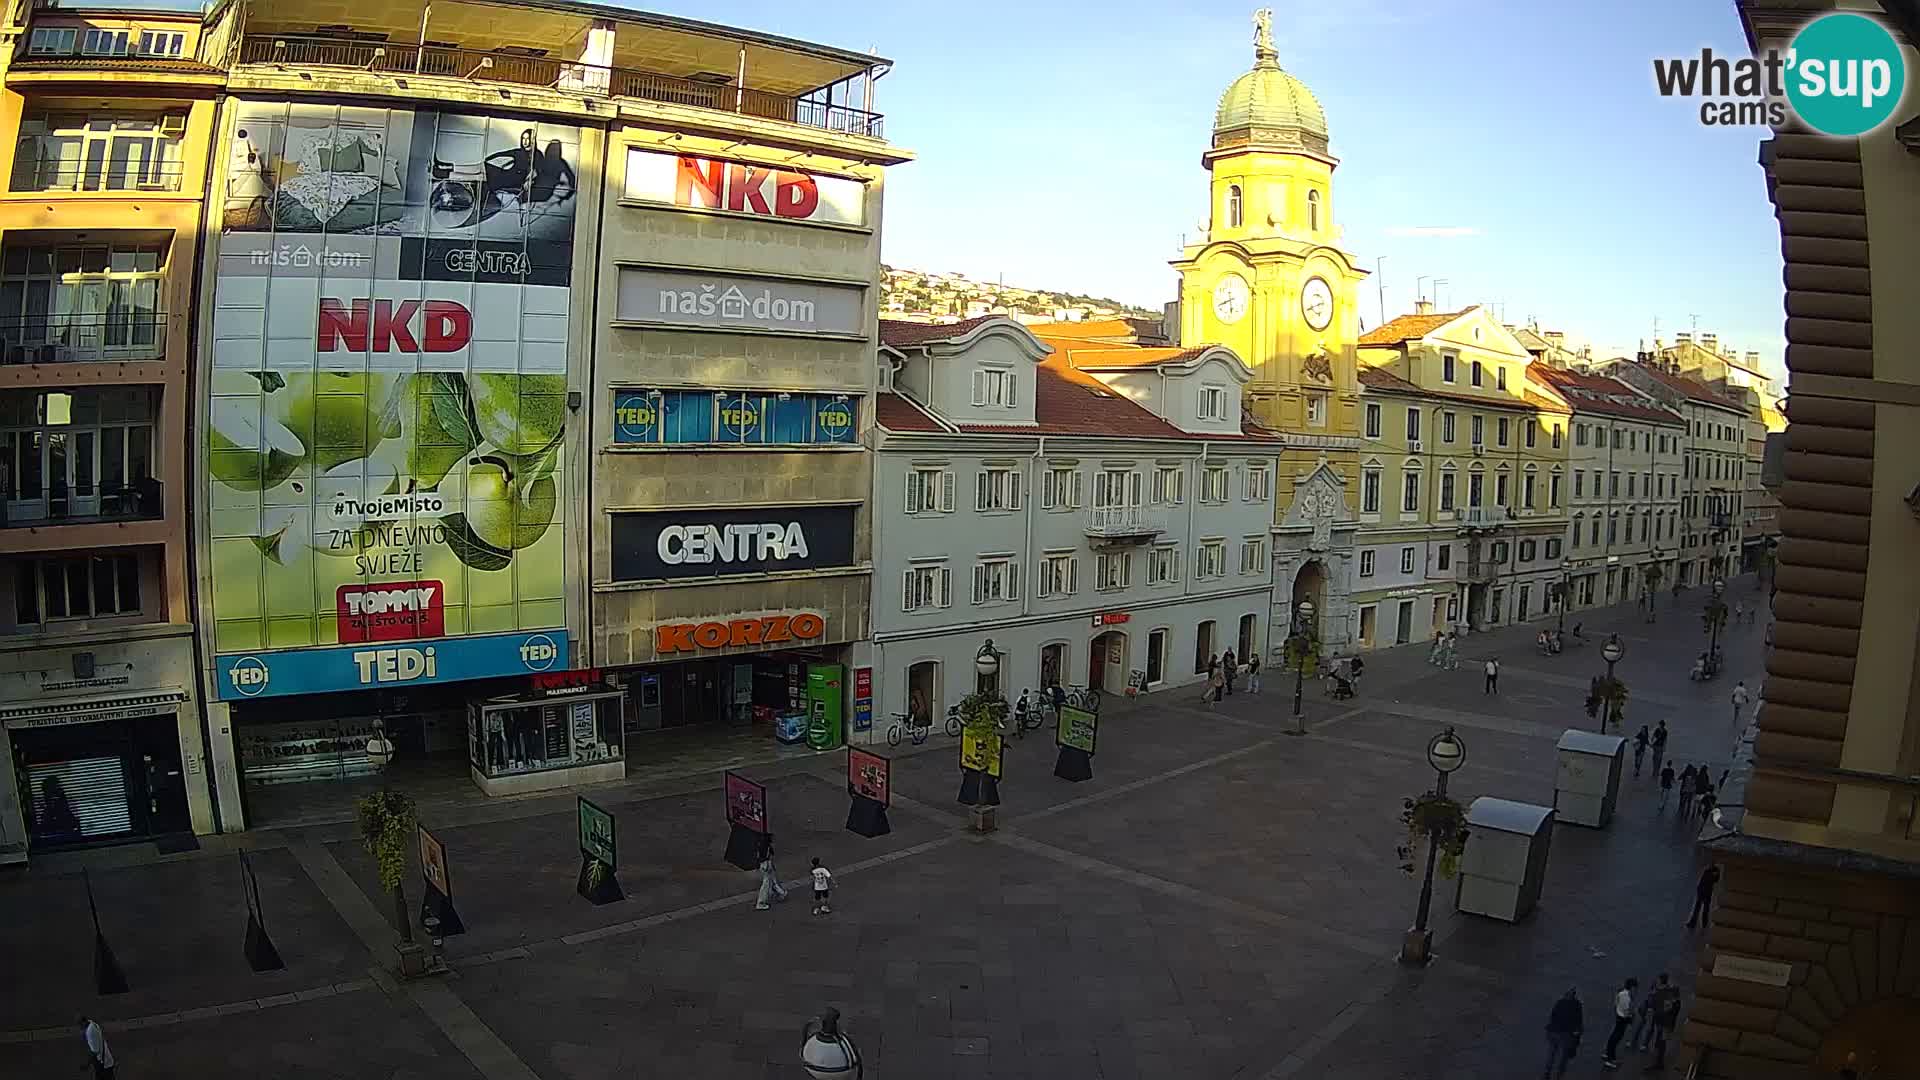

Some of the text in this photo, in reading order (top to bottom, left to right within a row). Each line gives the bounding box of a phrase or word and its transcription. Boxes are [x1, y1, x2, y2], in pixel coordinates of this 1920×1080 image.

[674, 153, 819, 219] NKD
[250, 244, 361, 267] naš dom
[445, 249, 531, 275] CENTRA
[659, 284, 815, 322] naš dom
[317, 297, 473, 353] NKD
[616, 408, 655, 426] TEDi
[722, 409, 758, 426] TEDi
[818, 411, 852, 427] TEDi
[334, 497, 443, 517] #TvojeMisto
[329, 524, 447, 550] ZA DNEVNO
[657, 521, 809, 565] CENTRA
[355, 548, 423, 576] SVJEŽE
[344, 587, 436, 616] TOMMY
[656, 613, 824, 653] KORZO
[353, 646, 437, 684] TEDi
[519, 642, 558, 662] TEDi
[229, 666, 270, 686] TEDi
